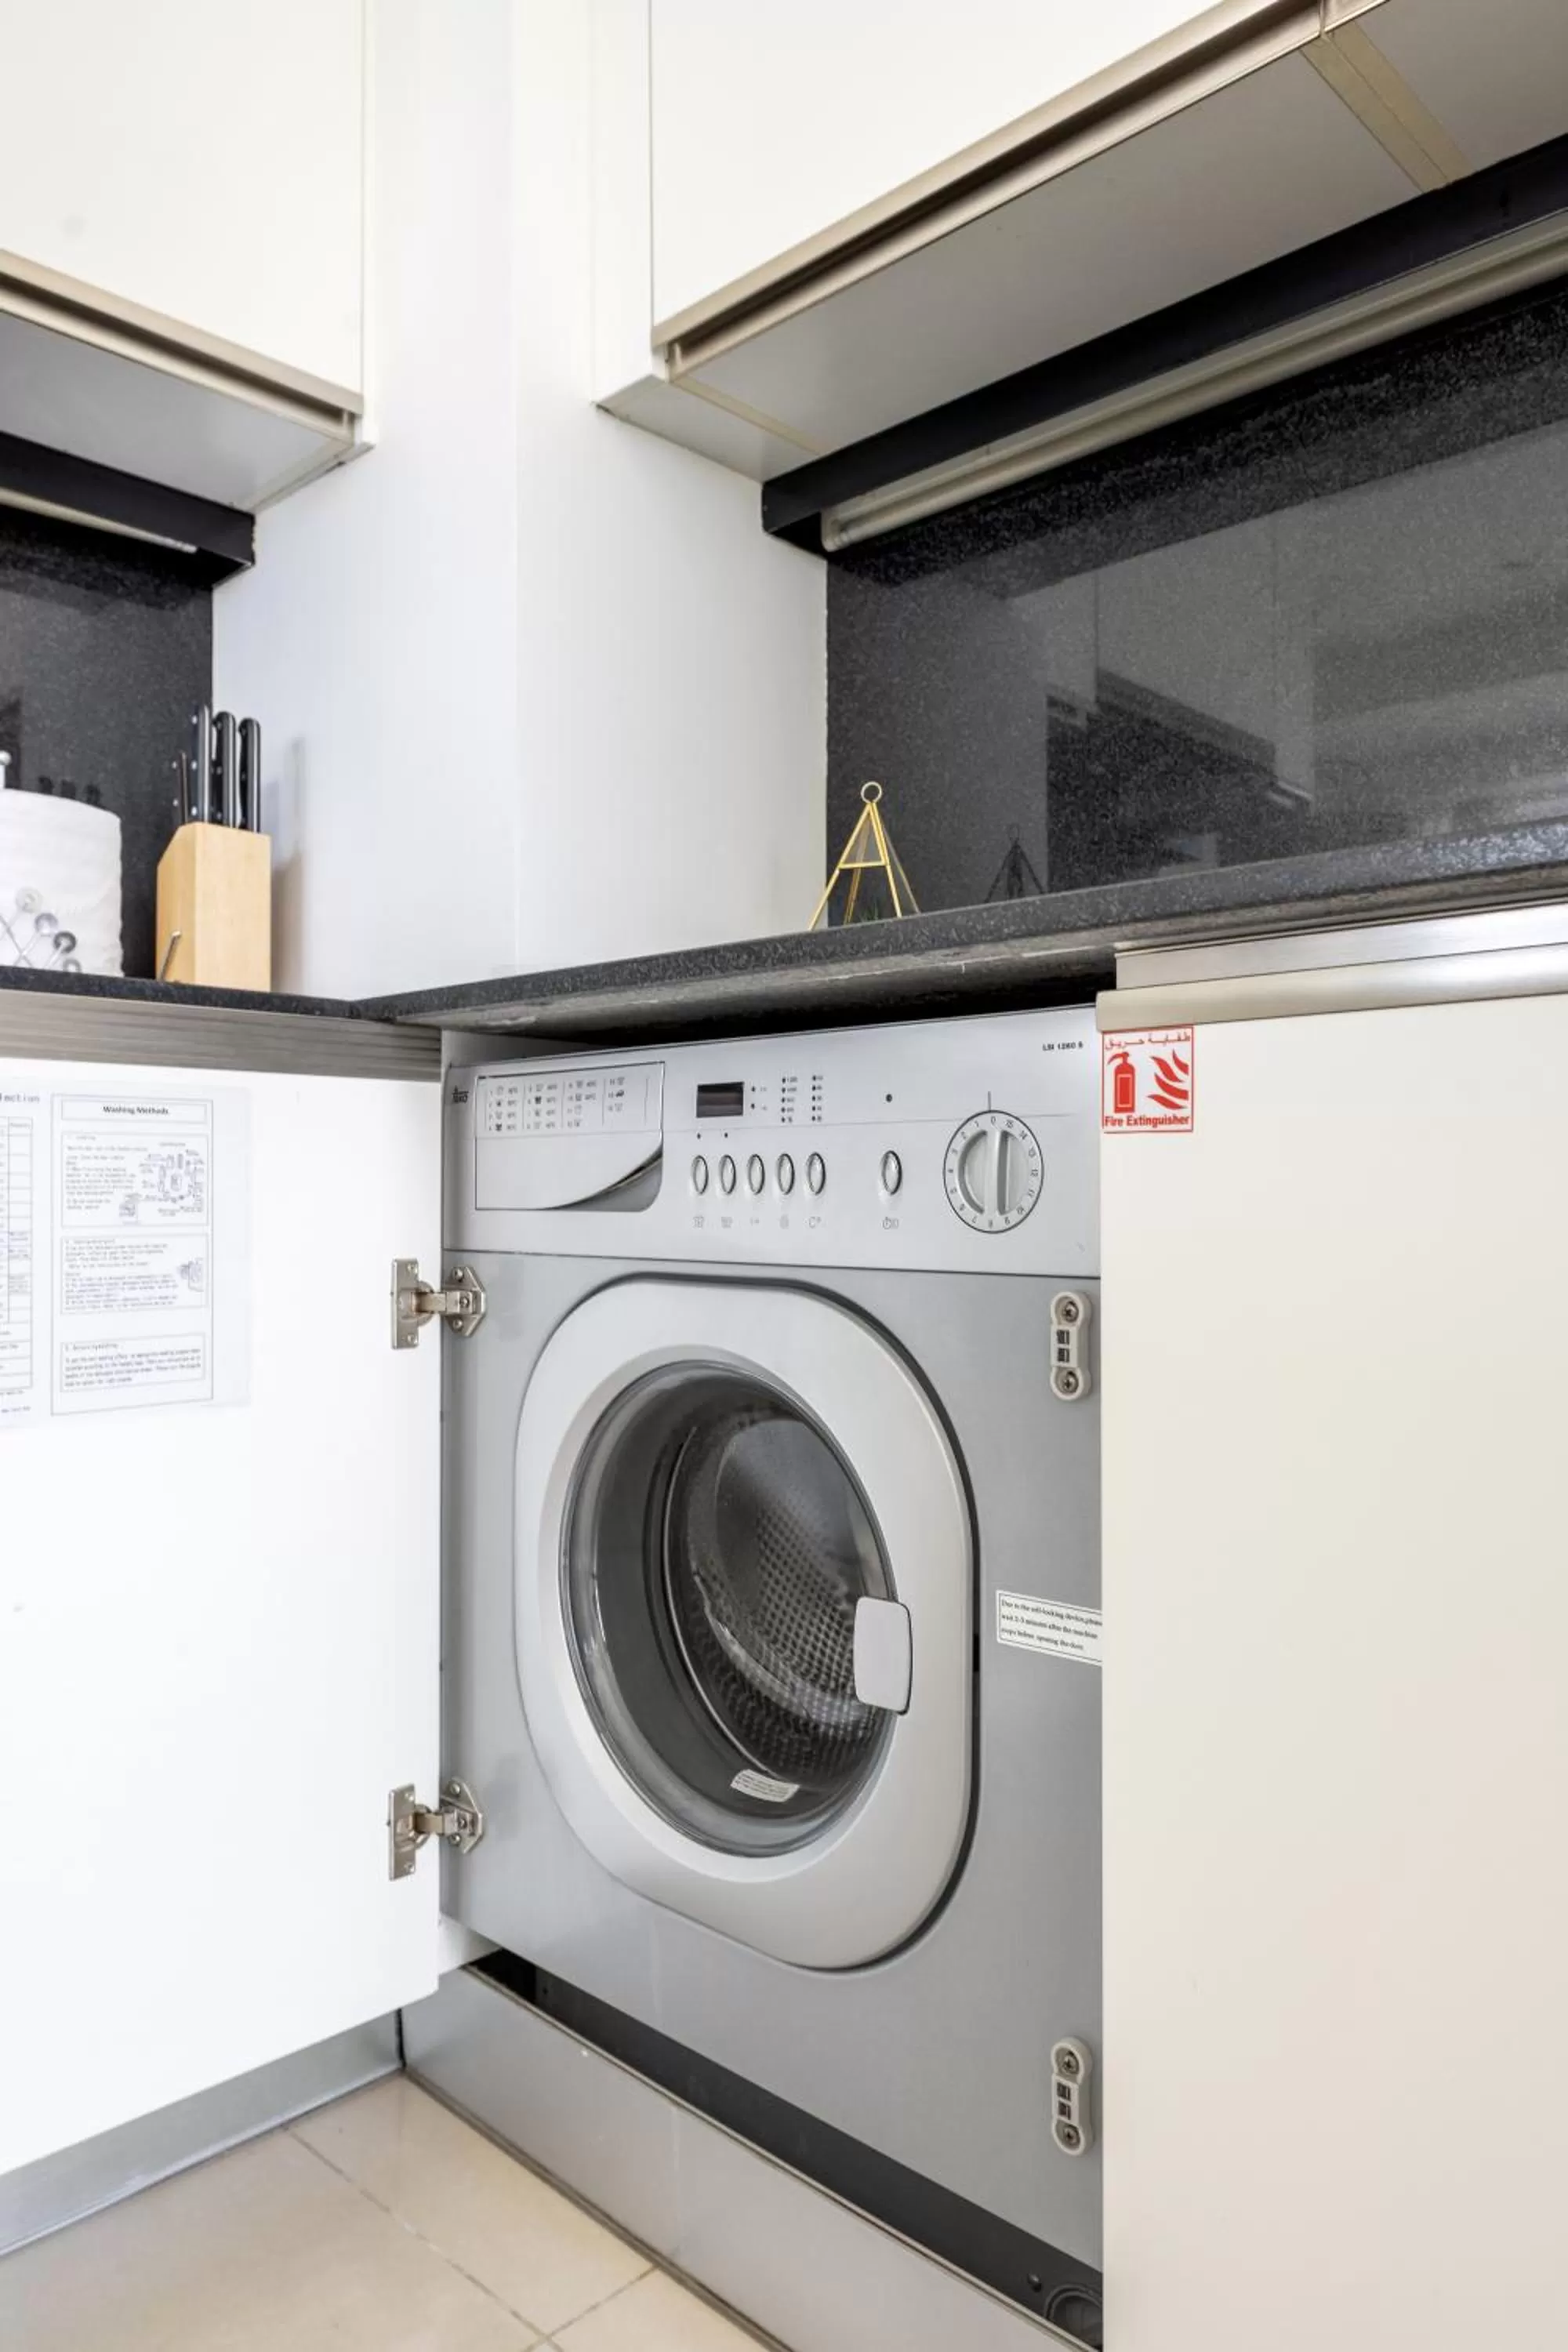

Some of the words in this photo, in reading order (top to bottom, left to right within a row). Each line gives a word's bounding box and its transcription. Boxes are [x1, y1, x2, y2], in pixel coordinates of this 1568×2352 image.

[103, 1106, 136, 1115] Washing
[1105, 1116, 1123, 1127] Fire
[1127, 1113, 1189, 1127] Extinguisher
